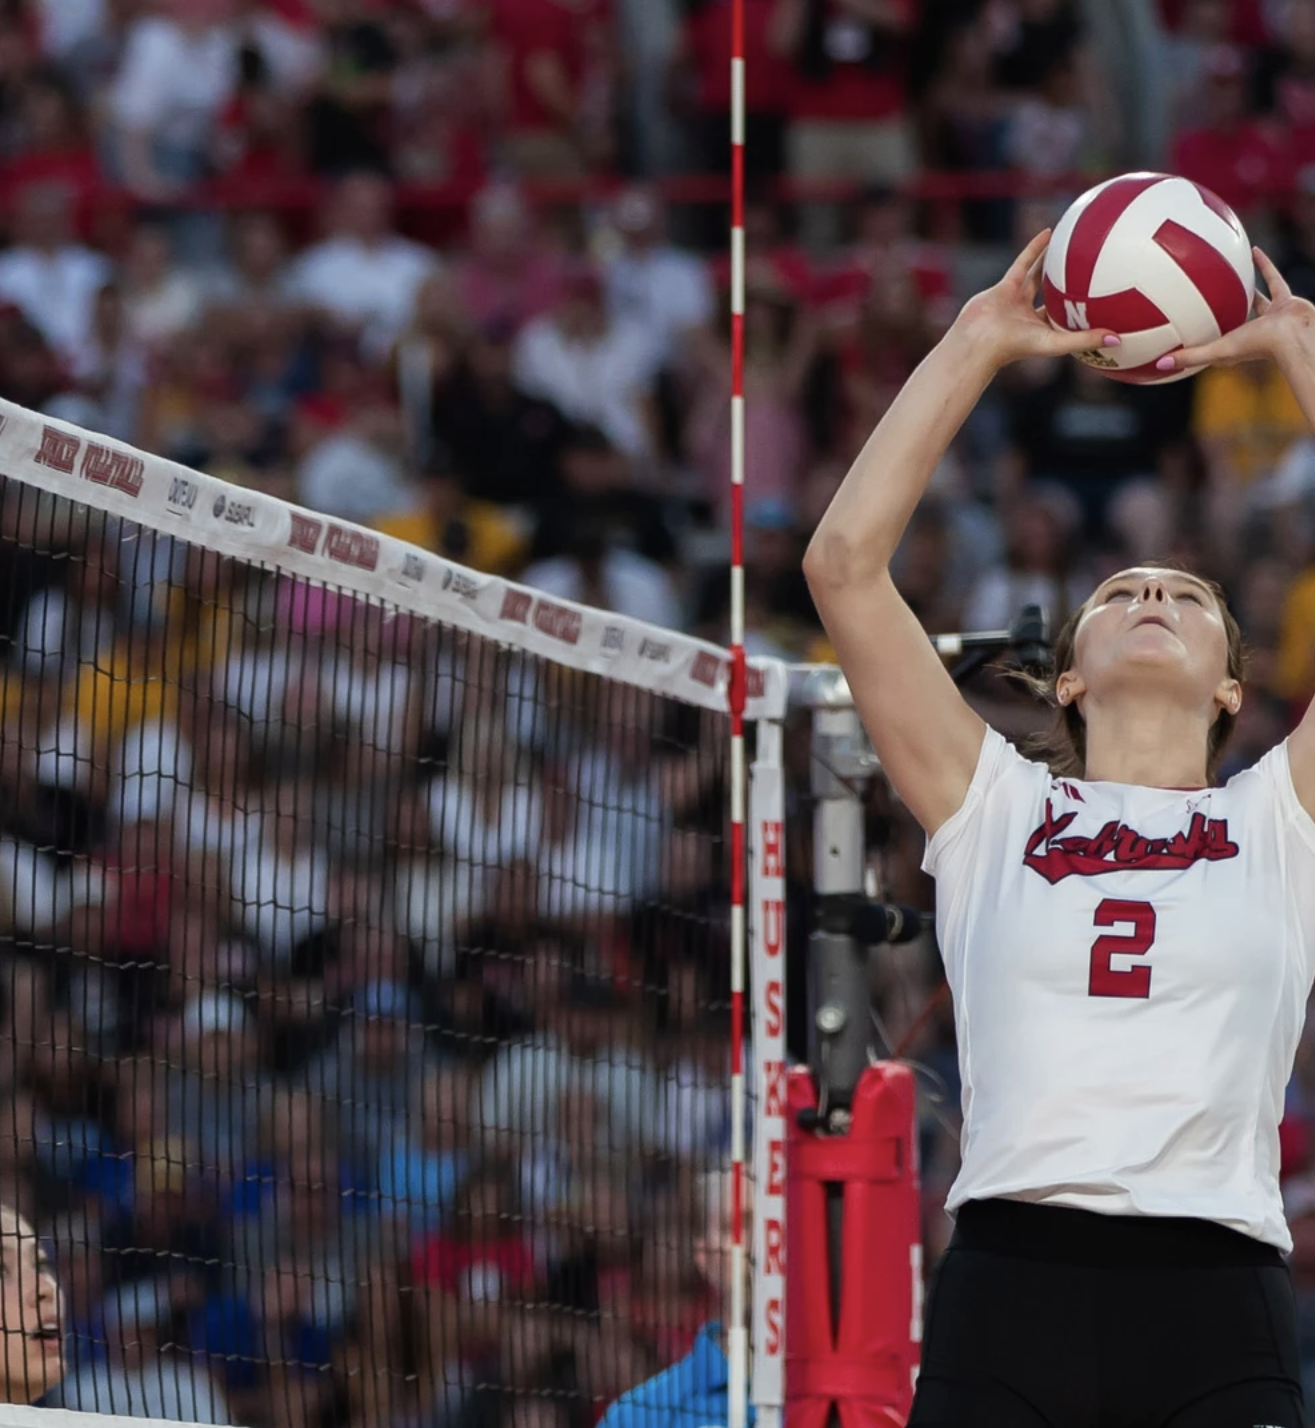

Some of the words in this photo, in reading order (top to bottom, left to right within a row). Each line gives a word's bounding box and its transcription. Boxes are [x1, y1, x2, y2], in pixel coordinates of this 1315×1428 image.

[1064, 299, 1090, 330] N
[1088, 898, 1156, 999] 2
[761, 820, 786, 1356] HUSKERS
